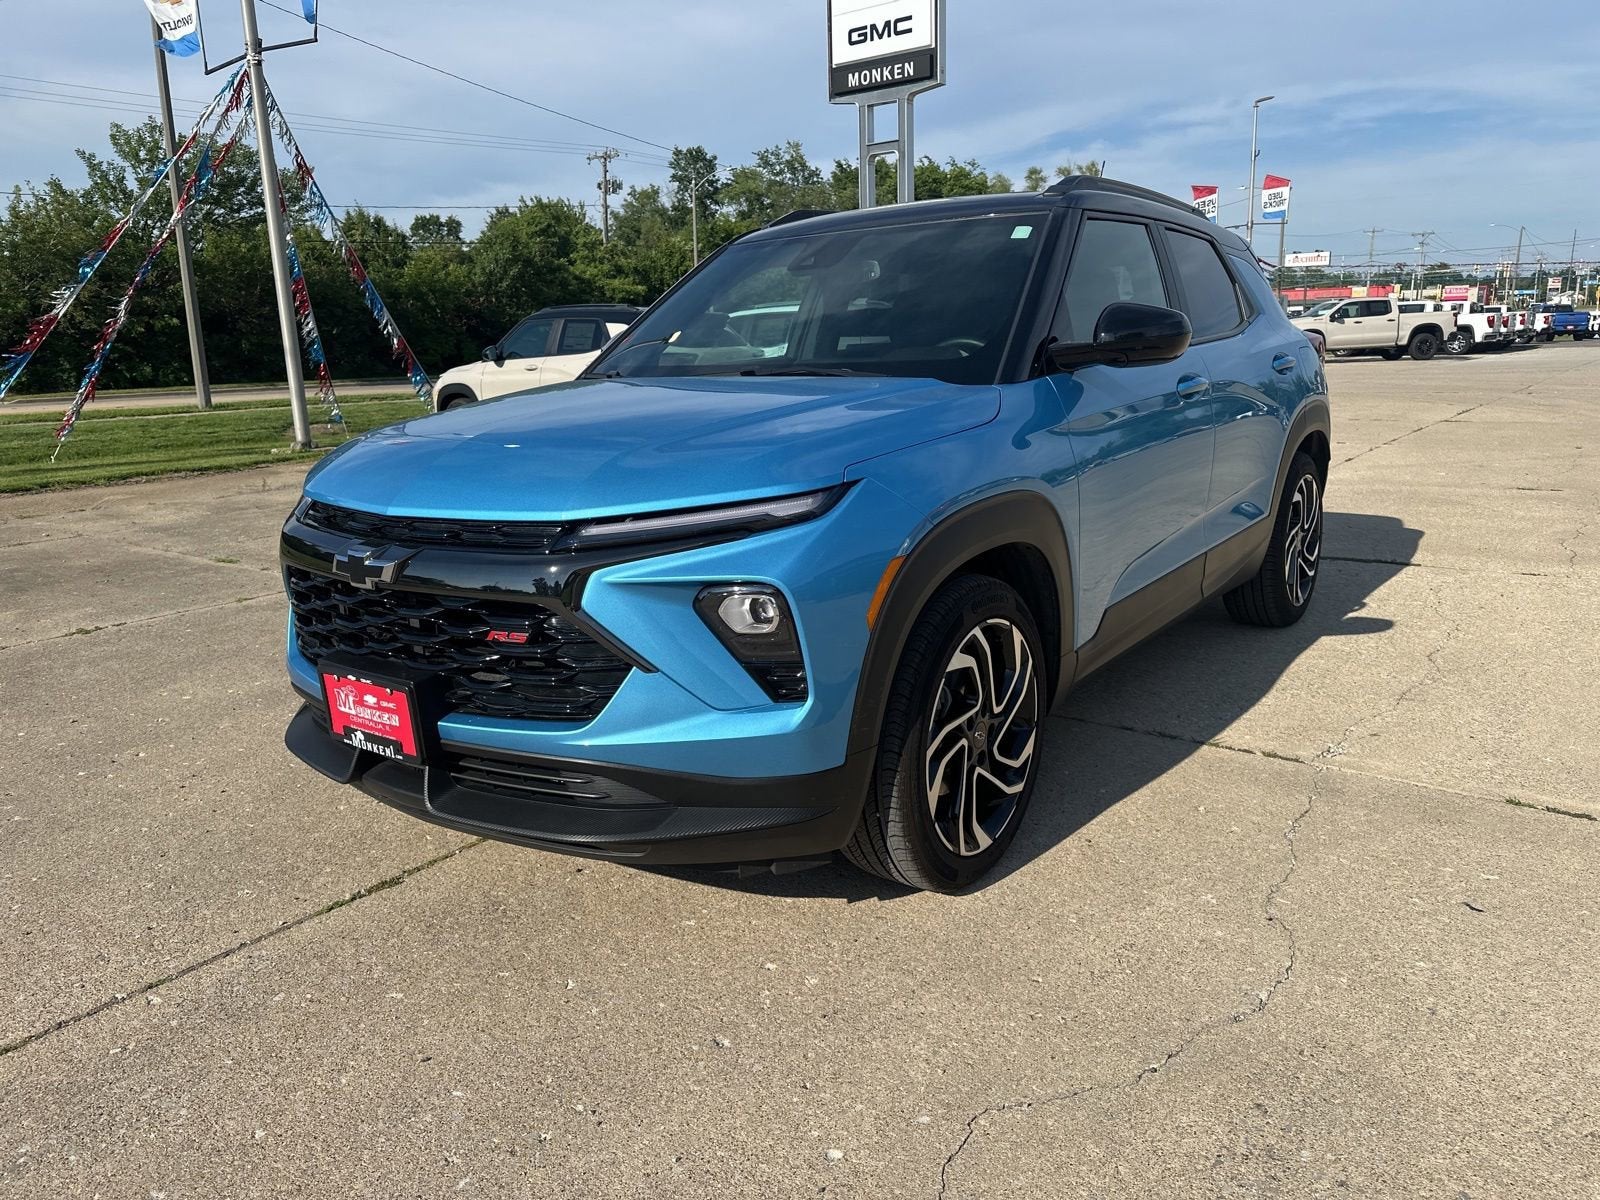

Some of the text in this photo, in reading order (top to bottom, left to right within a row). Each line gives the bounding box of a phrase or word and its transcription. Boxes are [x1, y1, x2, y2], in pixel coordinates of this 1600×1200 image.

[847, 14, 913, 46] GMC
[847, 61, 914, 88] MONKEN
[485, 630, 529, 643] RS
[379, 700, 397, 709] GMC
